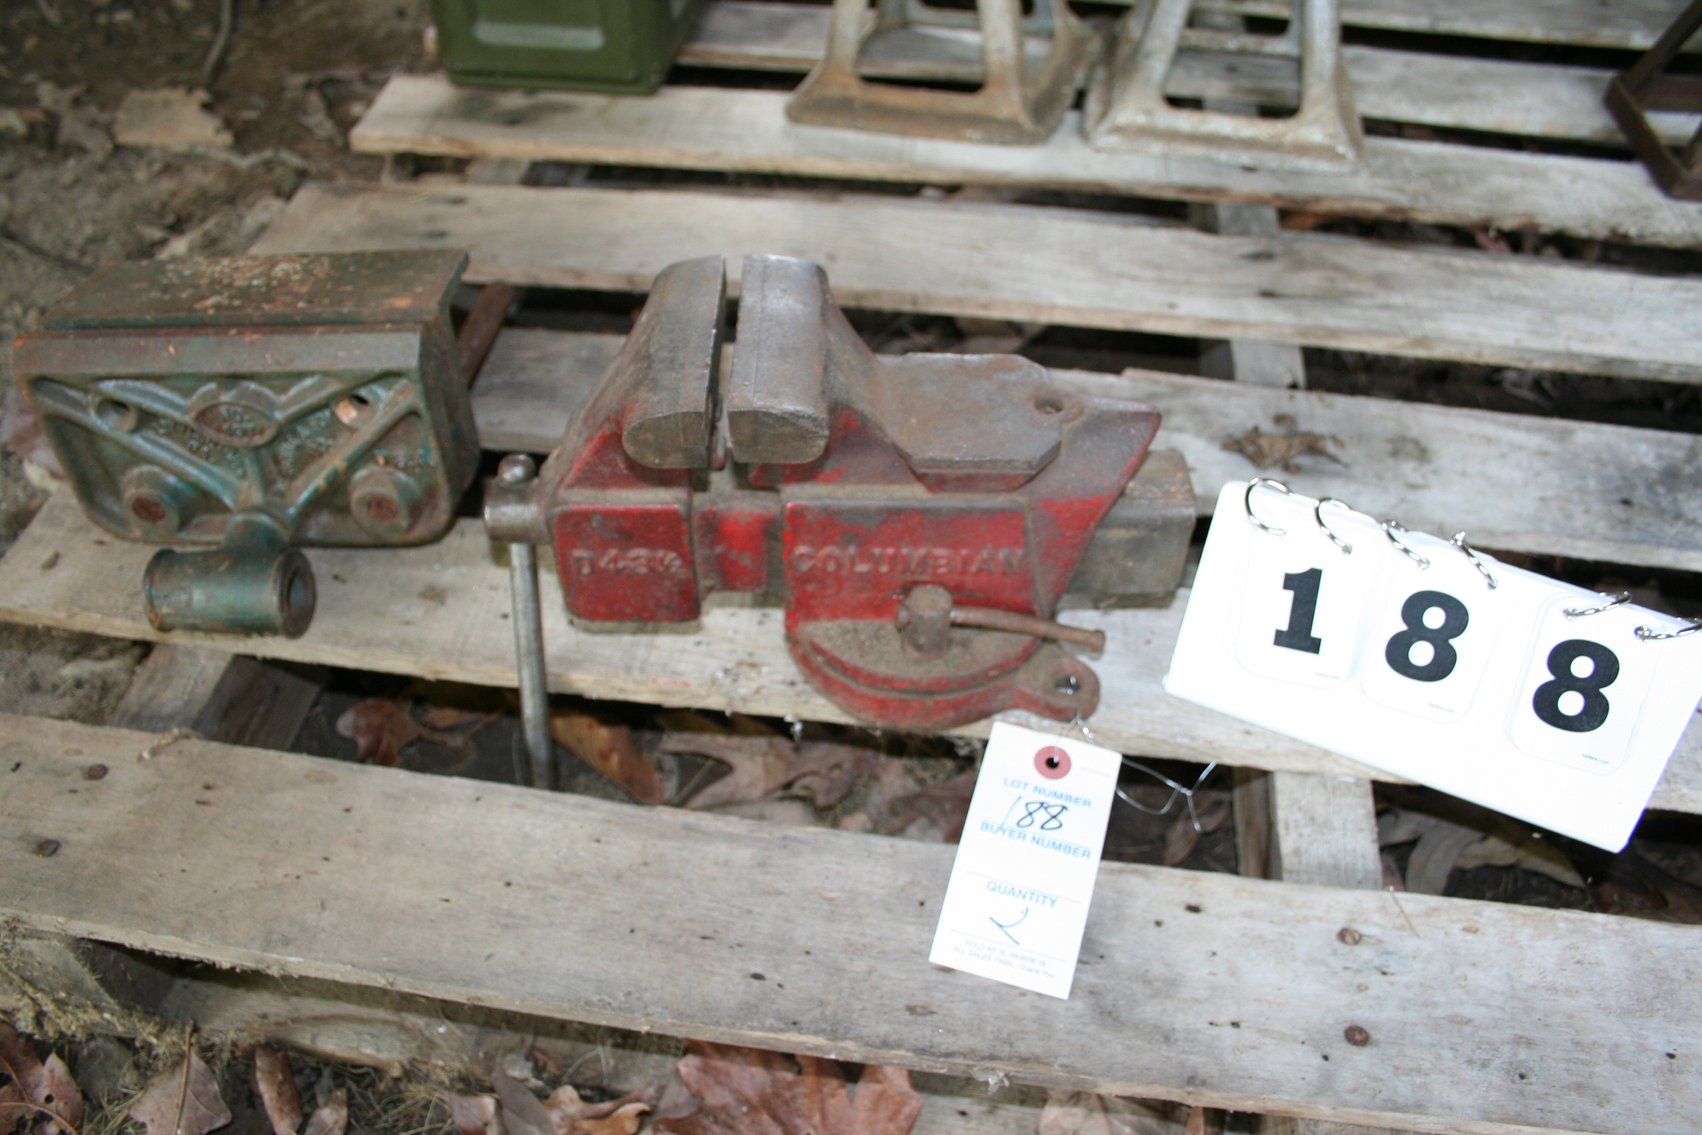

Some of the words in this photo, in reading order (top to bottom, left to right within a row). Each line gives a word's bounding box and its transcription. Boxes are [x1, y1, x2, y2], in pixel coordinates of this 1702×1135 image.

[793, 544, 1025, 574] COLUMBIAN
[1003, 777, 1029, 789] LOT
[1033, 785, 1092, 808] NUMBER
[1001, 795, 1068, 831] 188
[980, 820, 1026, 841] BUYER
[1031, 835, 1092, 860] NUMBER
[986, 880, 1058, 908] QUANTITY
